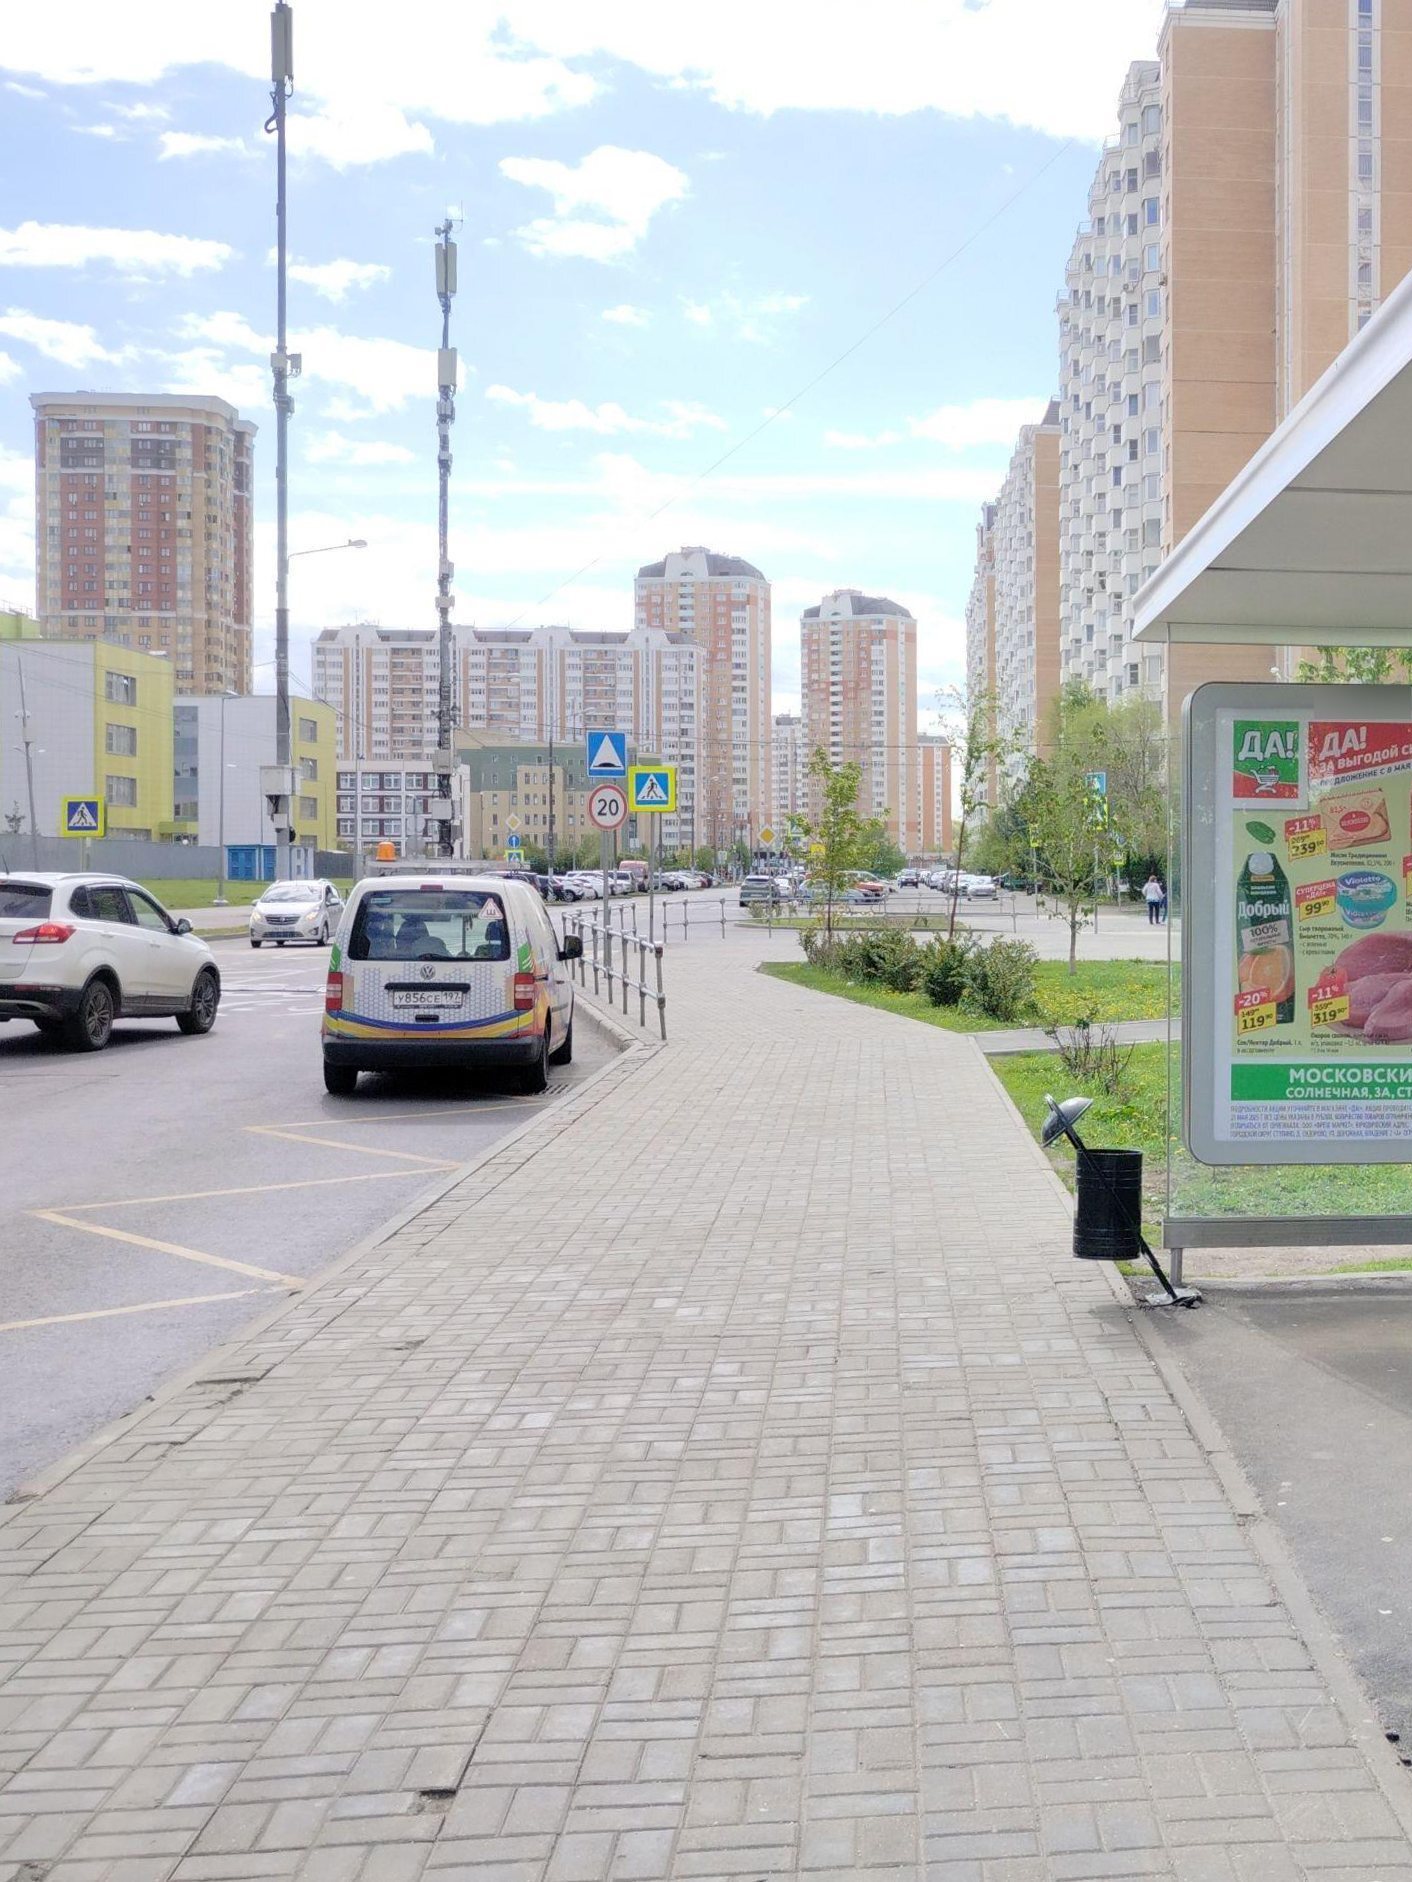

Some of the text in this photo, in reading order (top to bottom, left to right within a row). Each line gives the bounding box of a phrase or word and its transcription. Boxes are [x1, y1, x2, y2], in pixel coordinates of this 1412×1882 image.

[1238, 730, 1295, 761] ДА!
[1319, 726, 1367, 760] ДА!
[1319, 760, 1335, 774] ЗА
[1337, 745, 1399, 769] ВЫГОДОЙ
[1394, 762, 1411, 773] МАЯ
[597, 798, 619, 816] 20
[1238, 899, 1290, 920] Добрый
[1249, 923, 1278, 938] 100%
[1286, 1087, 1372, 1099] СОЛНЕЧНАЯ,
